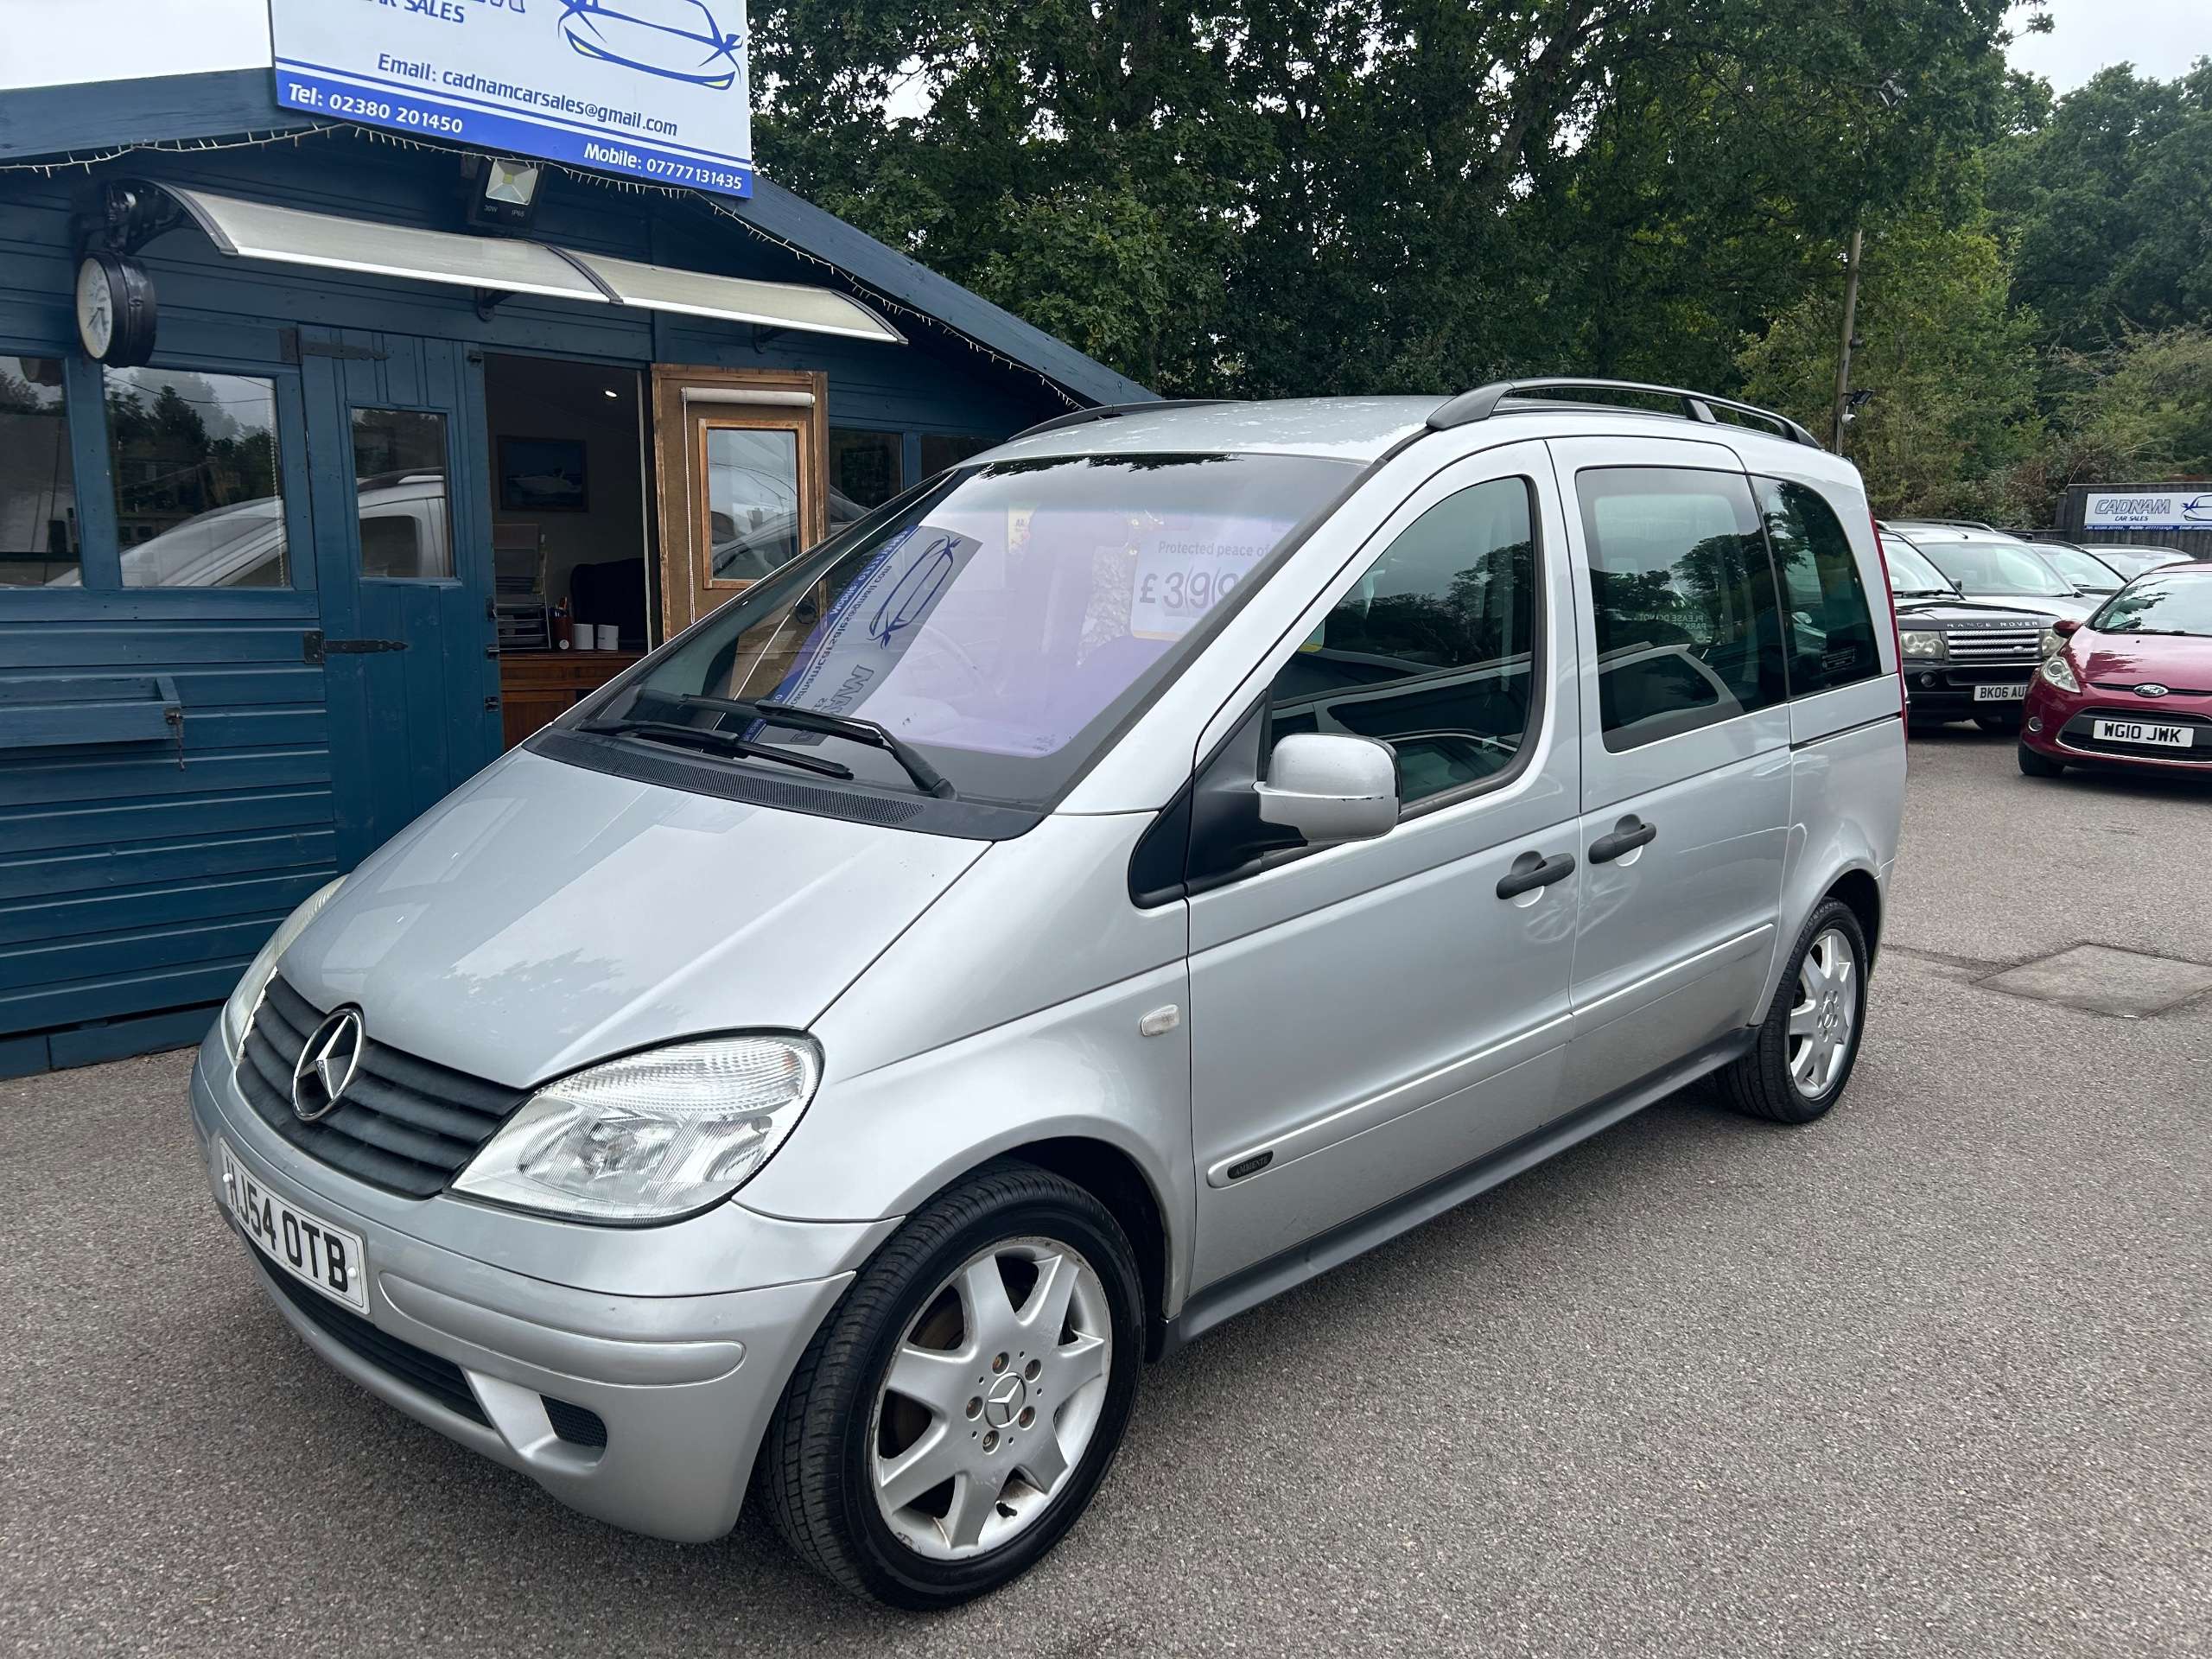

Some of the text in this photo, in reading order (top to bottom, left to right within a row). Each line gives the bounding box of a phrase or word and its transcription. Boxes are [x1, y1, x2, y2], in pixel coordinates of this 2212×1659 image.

[288, 83, 464, 134] Tel: 02380 201450
[378, 53, 678, 137] Email: cadnamcarsales@gmail.com
[583, 143, 743, 190] Mobile: 07777131435
[2094, 499, 2171, 515] CADNAM
[1158, 541, 1271, 557] Protected peace of
[1980, 686, 2028, 699] BK06 AU
[2104, 722, 2182, 743] WG10 JWK
[282, 1210, 348, 1293] OTB
